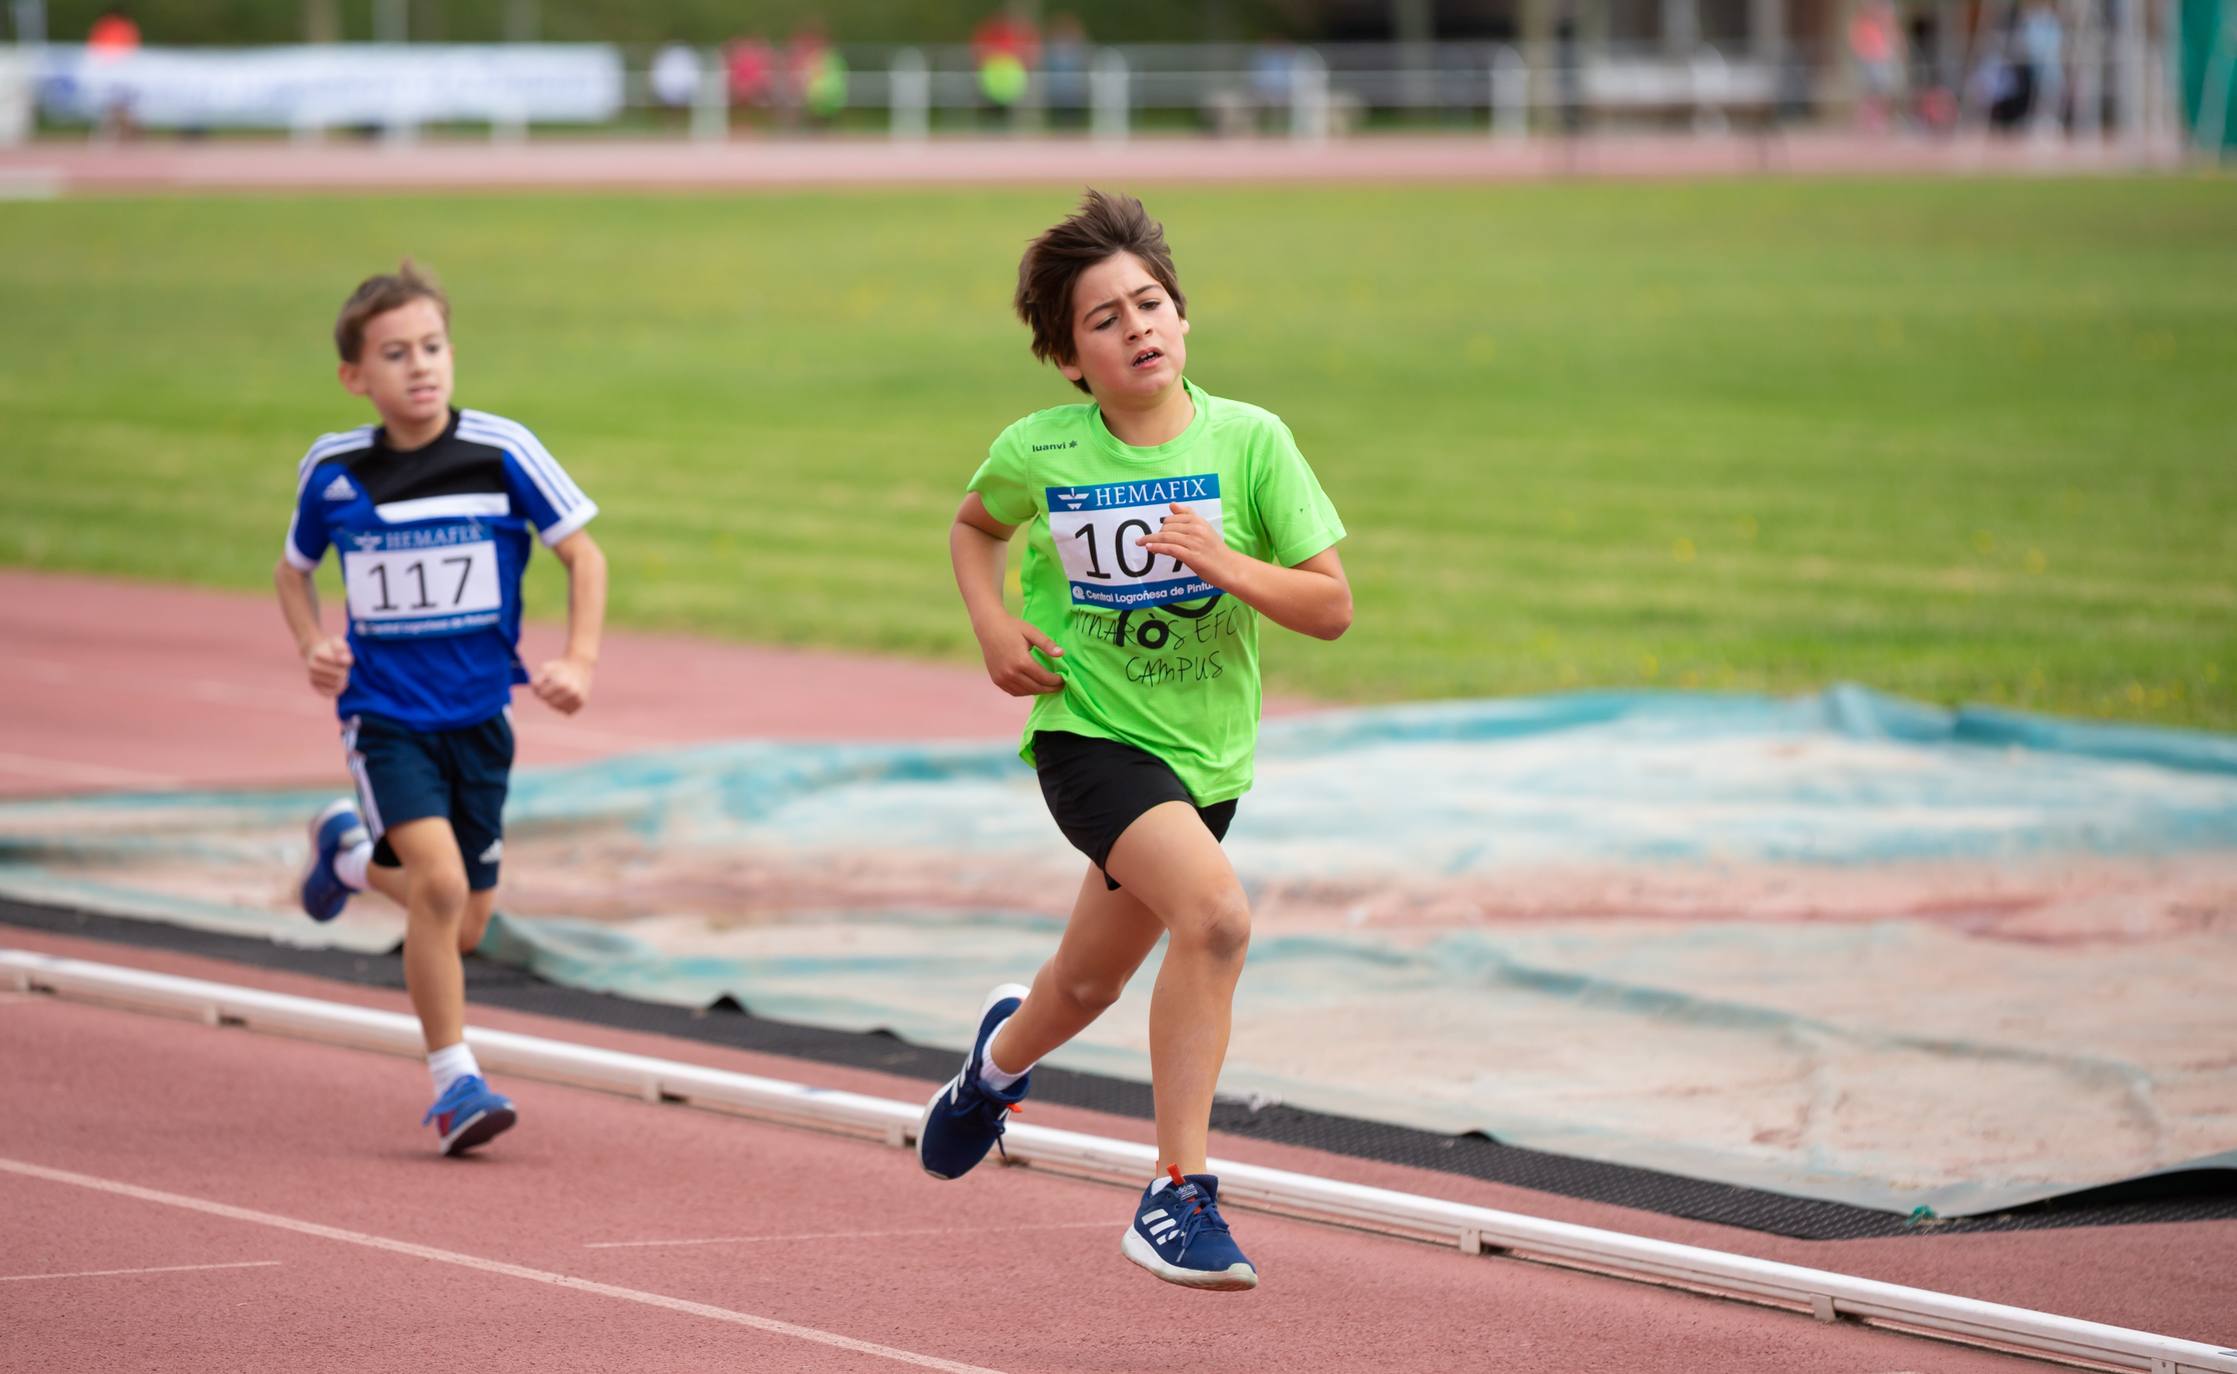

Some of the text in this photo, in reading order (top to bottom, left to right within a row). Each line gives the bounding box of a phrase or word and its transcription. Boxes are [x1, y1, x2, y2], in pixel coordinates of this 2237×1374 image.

[1095, 478, 1207, 506] HEMAFIX
[368, 555, 473, 612] 117
[1086, 589, 1114, 603] Central
[1115, 589, 1168, 605] Logroñesa
[1170, 585, 1185, 597] de
[1195, 605, 1238, 644] EFC
[1125, 650, 1224, 687] CAMPUS
